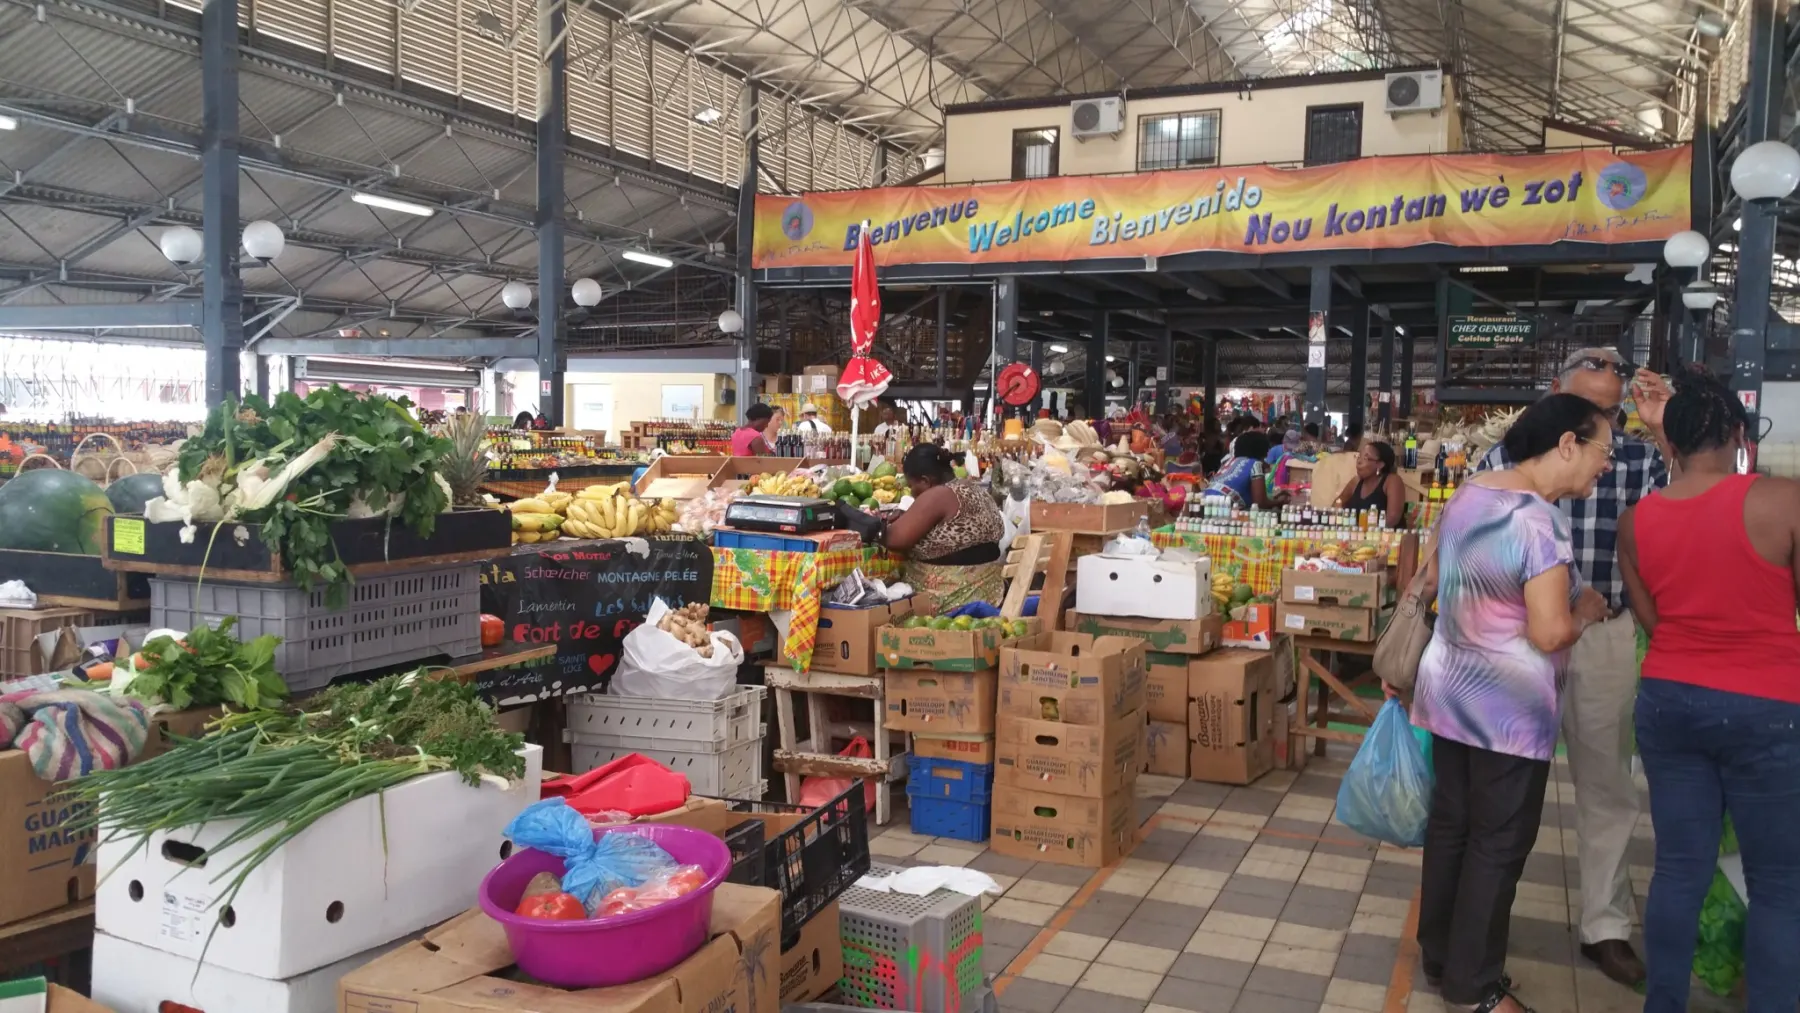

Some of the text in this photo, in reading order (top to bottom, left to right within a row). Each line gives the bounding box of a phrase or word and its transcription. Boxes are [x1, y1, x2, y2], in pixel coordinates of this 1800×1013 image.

[1089, 178, 1262, 246] Bienvenido
[1244, 170, 1583, 246] Nou kontan wè zot
[967, 196, 1096, 254] Welcome
[1452, 325, 1531, 333] CHEZ GENEVIEVE
[1466, 315, 1517, 323] Restaurant
[1458, 334, 1524, 342] Cuisine Créole
[480, 563, 517, 585] ata
[597, 568, 698, 583] MONTAGNE PELÉE
[513, 622, 561, 644] Fort
[569, 620, 601, 640] de
